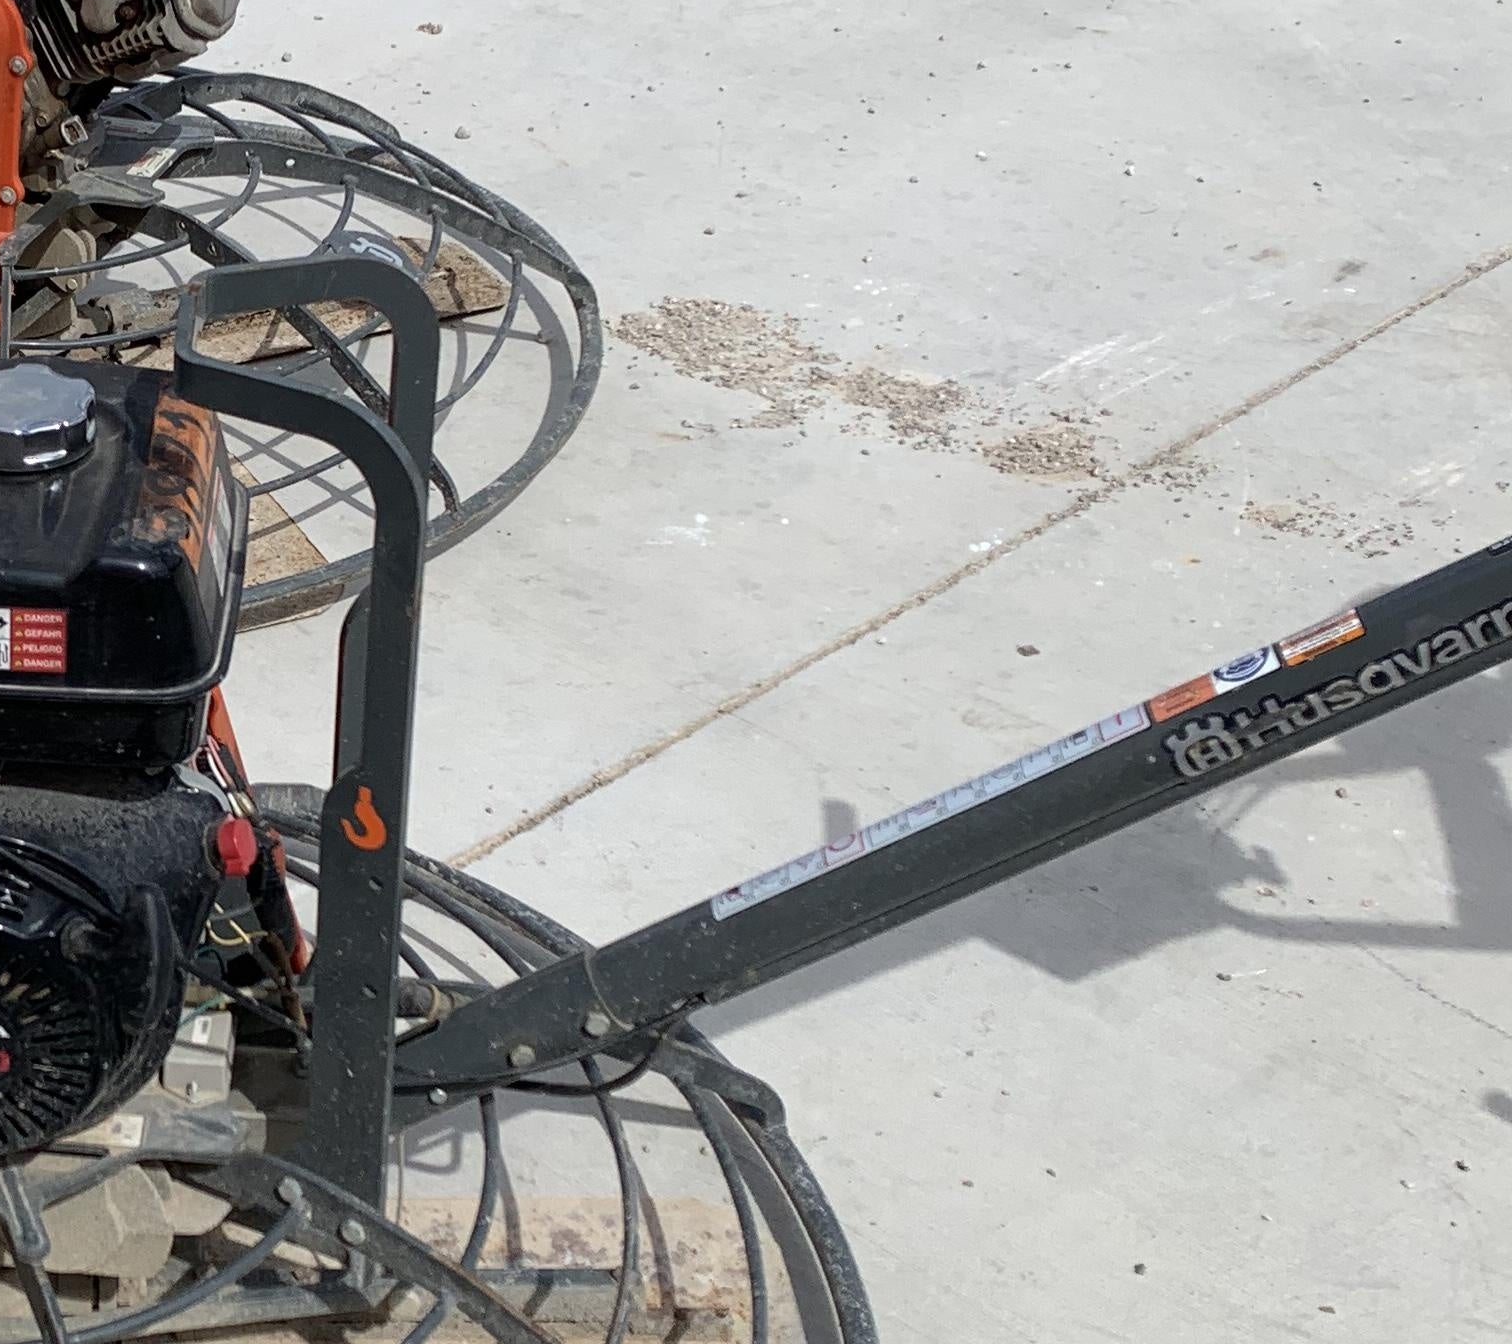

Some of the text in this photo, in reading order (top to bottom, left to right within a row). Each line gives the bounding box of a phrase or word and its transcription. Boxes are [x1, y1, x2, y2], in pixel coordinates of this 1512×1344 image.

[23, 614, 63, 623] DANGER
[23, 629, 63, 639] GEFAHR
[22, 643, 63, 654] PELIGRO
[22, 658, 63, 668] DANGER
